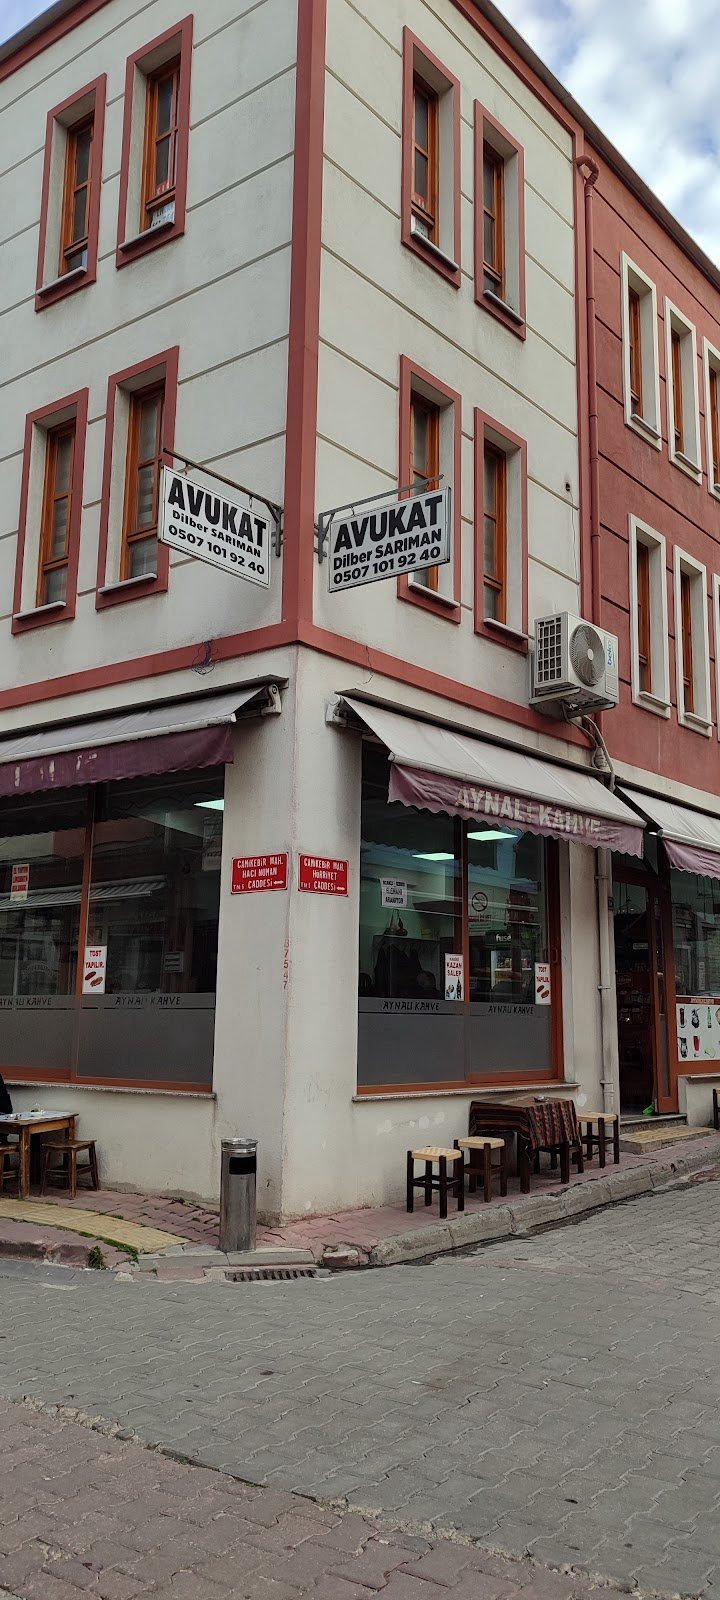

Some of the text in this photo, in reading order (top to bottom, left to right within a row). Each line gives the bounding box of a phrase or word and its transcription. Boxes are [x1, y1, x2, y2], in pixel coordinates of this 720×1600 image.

[167, 477, 267, 548] AVUKAT
[333, 494, 443, 554] AVUKAT
[168, 524, 265, 575] 0507 101 92 40
[172, 509, 261, 558] Dilber SARIMAN
[333, 528, 442, 571] Dilber SARIMAN
[333, 546, 441, 585] 0507 101 92 40
[539, 804, 601, 834] KAHVE
[242, 866, 278, 879] HACI NUMAN
[150, 996, 181, 1006] KAHVE
[414, 1001, 440, 1011] KAHVE
[513, 1005, 534, 1015] KAHVE
